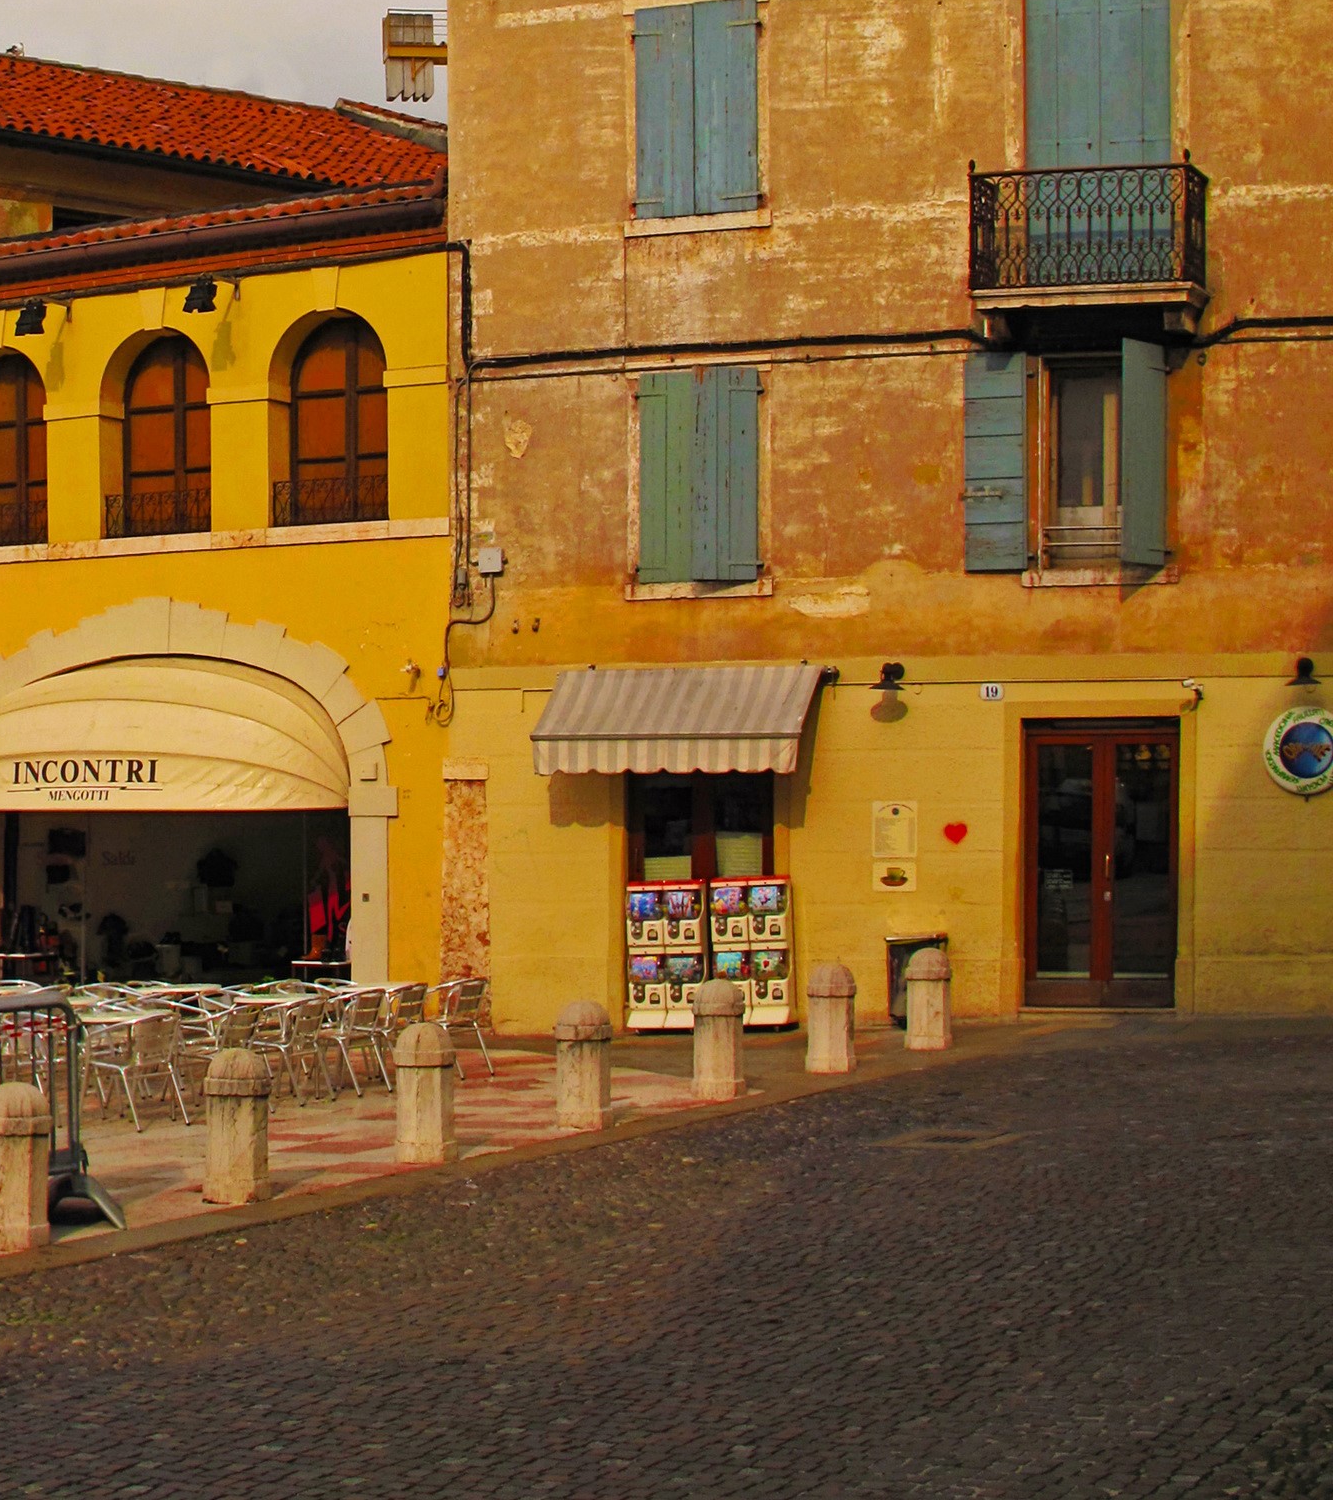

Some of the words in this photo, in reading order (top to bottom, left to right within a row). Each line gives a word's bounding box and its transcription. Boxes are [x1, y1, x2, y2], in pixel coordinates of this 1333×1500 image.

[986, 685, 998, 698] 19
[13, 759, 158, 784] INCONTRI
[48, 790, 110, 801] MENGOTTI
